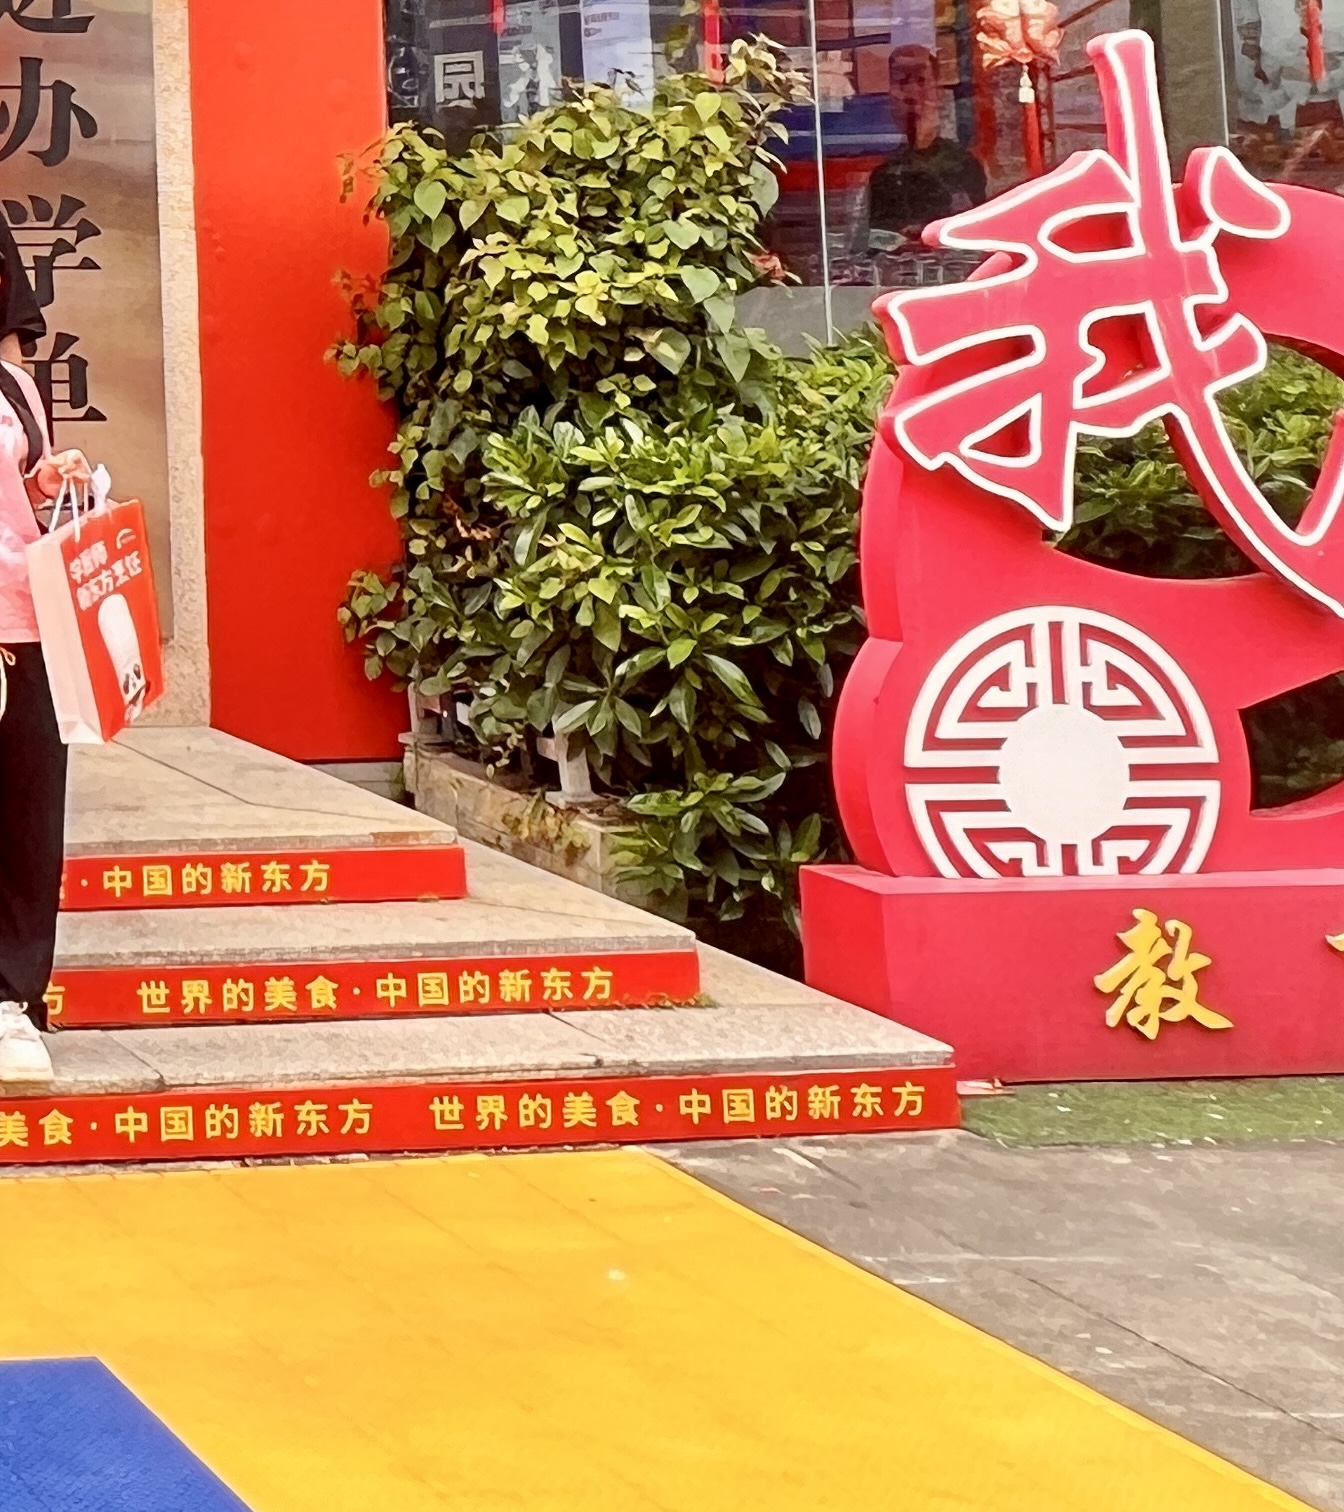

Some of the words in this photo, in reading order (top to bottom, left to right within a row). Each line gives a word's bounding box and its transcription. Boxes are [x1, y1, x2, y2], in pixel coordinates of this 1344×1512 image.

[138, 966, 614, 1015] 世界的美食·中国的新东方
[428, 1081, 925, 1133] 世界的美食·中国的新东方
